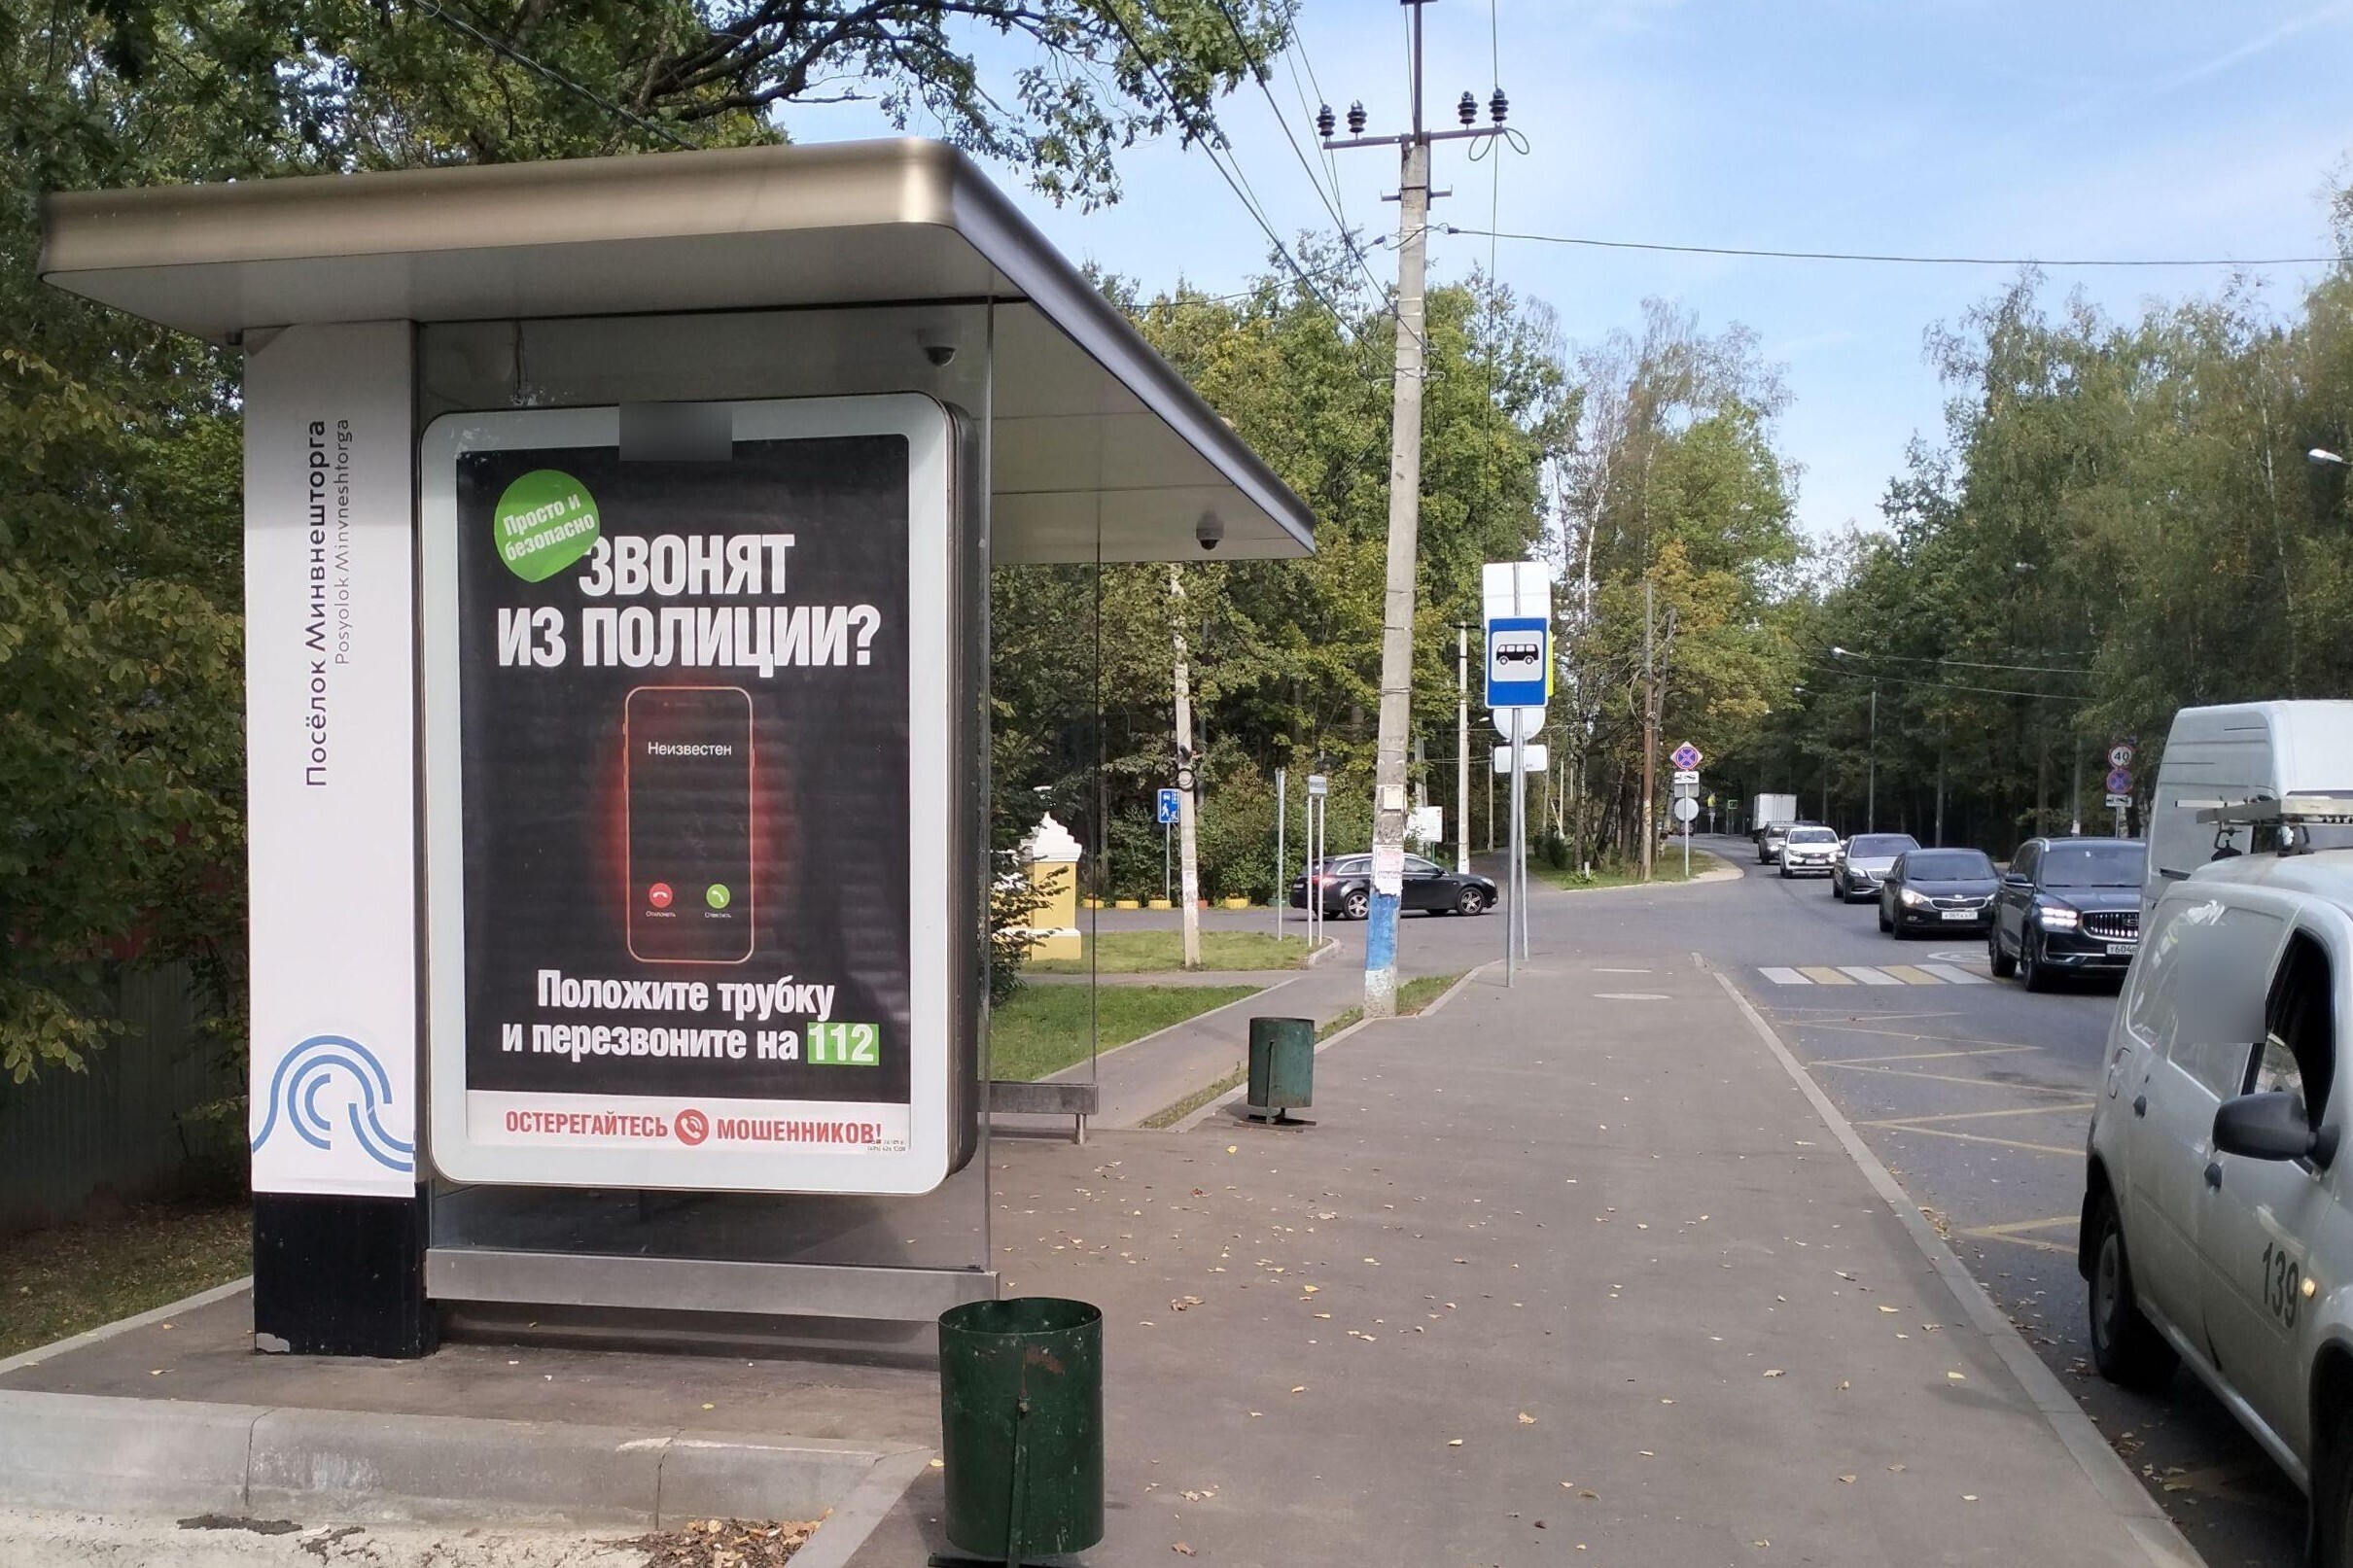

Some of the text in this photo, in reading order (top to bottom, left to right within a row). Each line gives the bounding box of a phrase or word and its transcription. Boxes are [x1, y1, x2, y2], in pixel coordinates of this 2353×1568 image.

[503, 494, 581, 537] Просто и
[505, 513, 595, 561] безопасно
[334, 419, 353, 665] Posyolok Minvneshtorga
[579, 534, 795, 597] ЗВОНЯТ
[305, 420, 331, 786] Посёлок Минвнешторга
[498, 604, 881, 679] ИЗ ПОЛИЦИИ?
[647, 741, 732, 757] Неизвестен
[2114, 751, 2130, 761] 40
[538, 969, 835, 1022] Положите трубку
[502, 1023, 874, 1063] и перезвоните на 112
[506, 1110, 882, 1144] ОСТЕРЕГАЙТЕСЬ МОШЕННИКОВ!
[2263, 1242, 2300, 1329] 139
